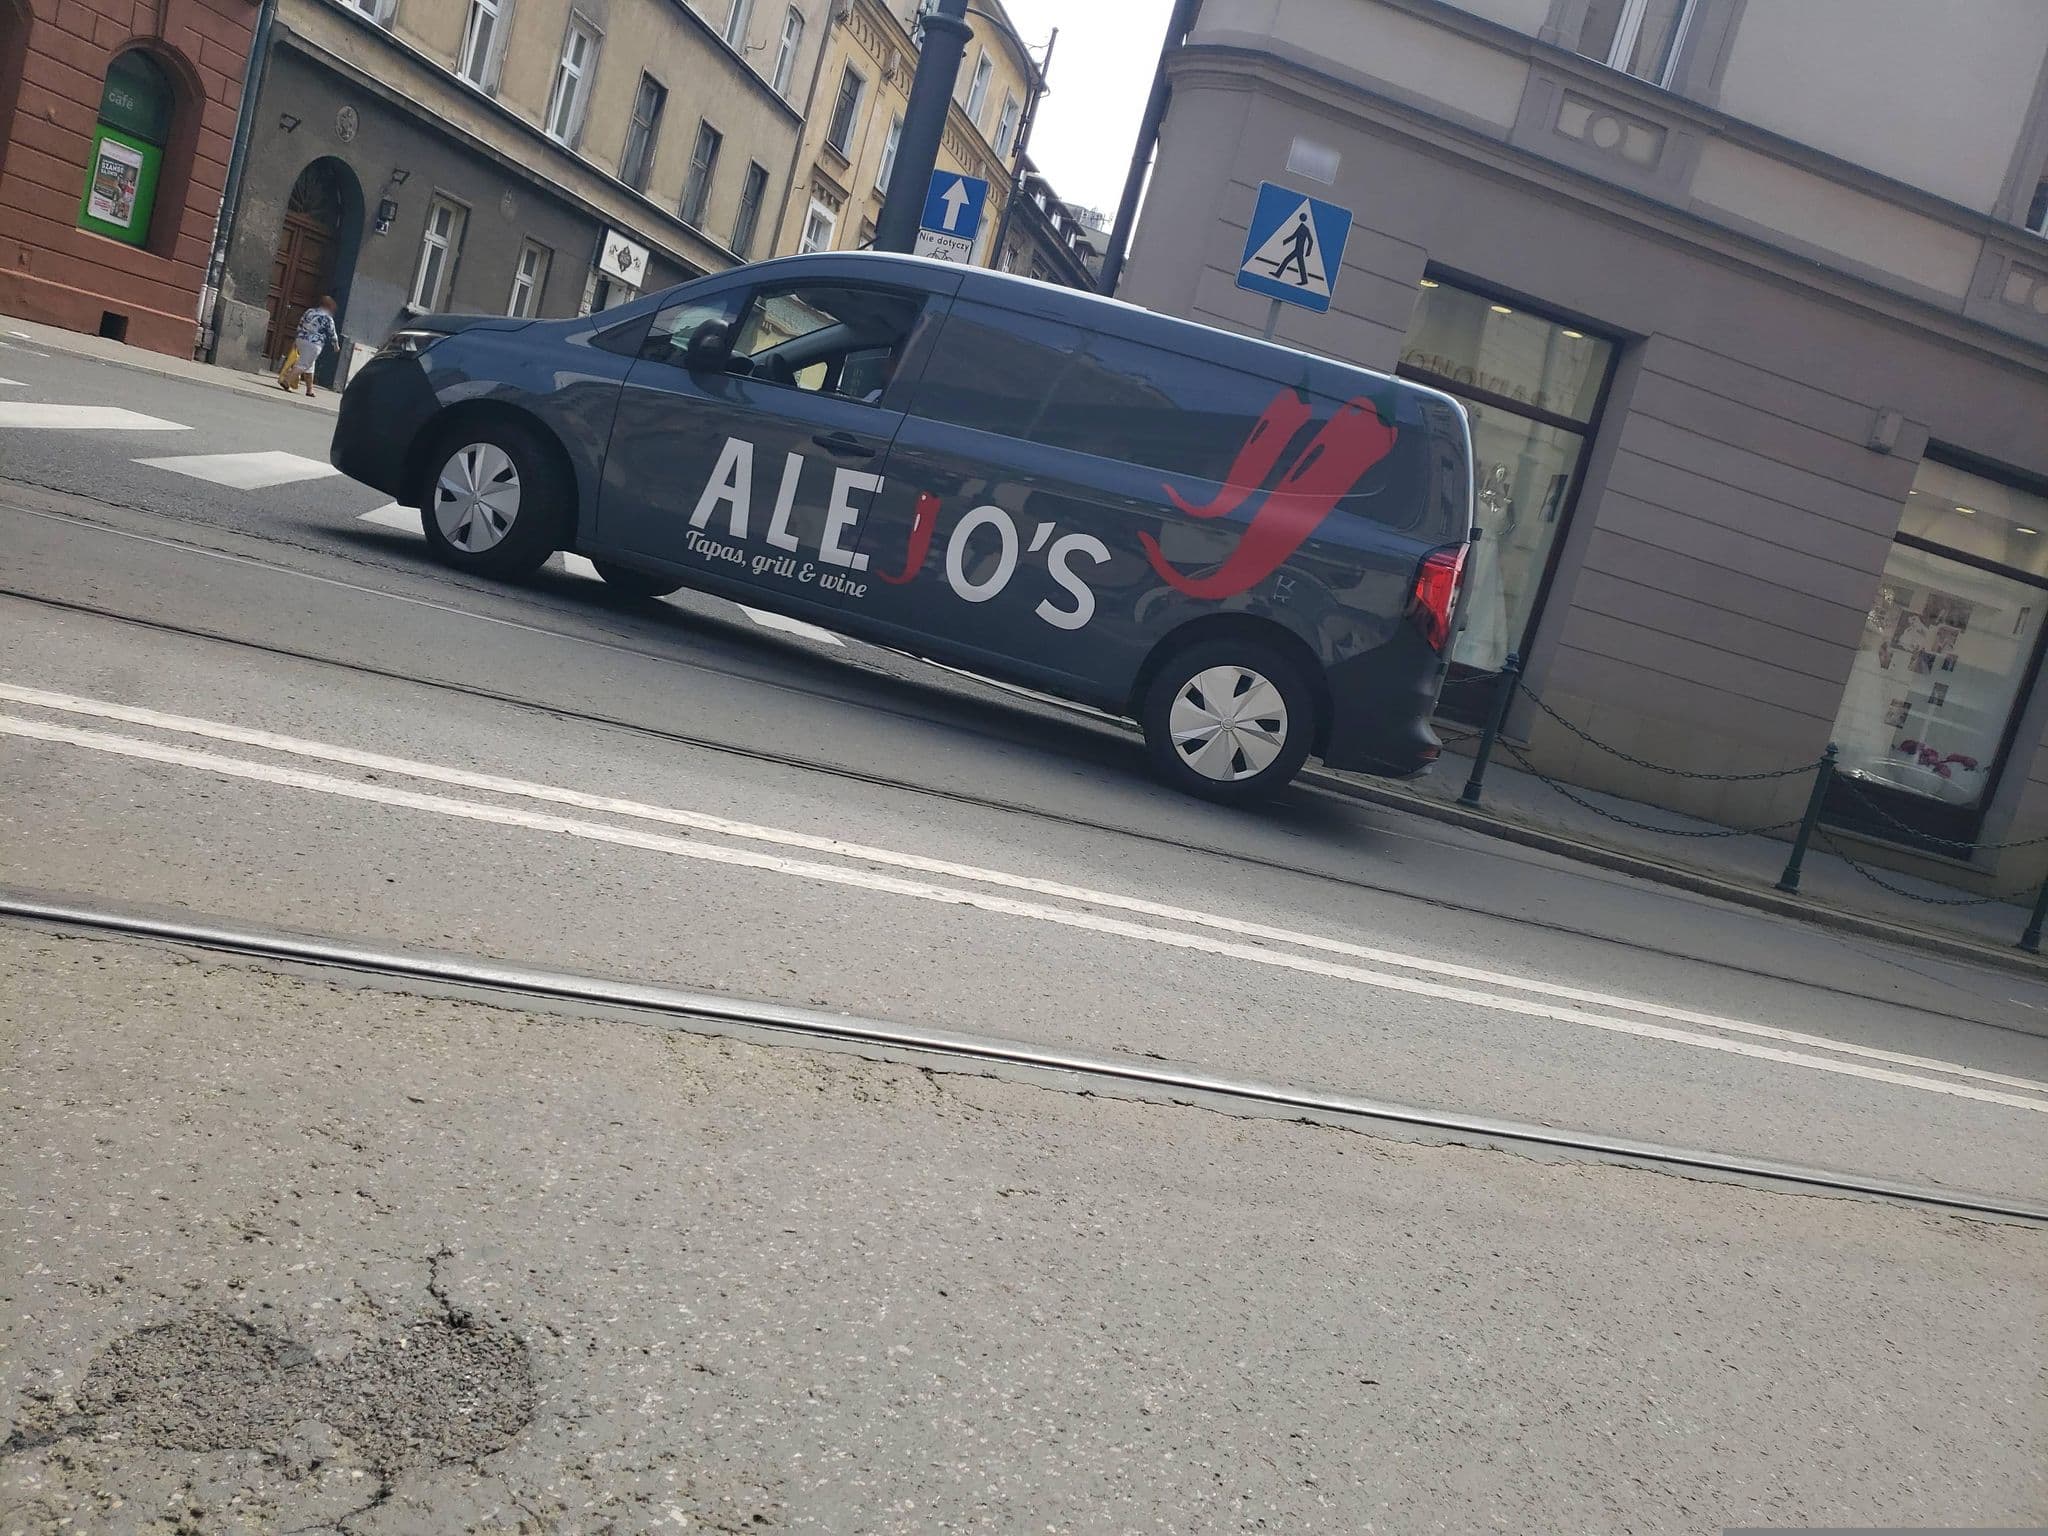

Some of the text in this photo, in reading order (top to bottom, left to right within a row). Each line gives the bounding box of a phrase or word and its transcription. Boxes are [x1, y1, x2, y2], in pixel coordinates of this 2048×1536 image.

[919, 231, 969, 252] Nie dotyczy
[686, 530, 868, 598] Tapas, grill & wine
